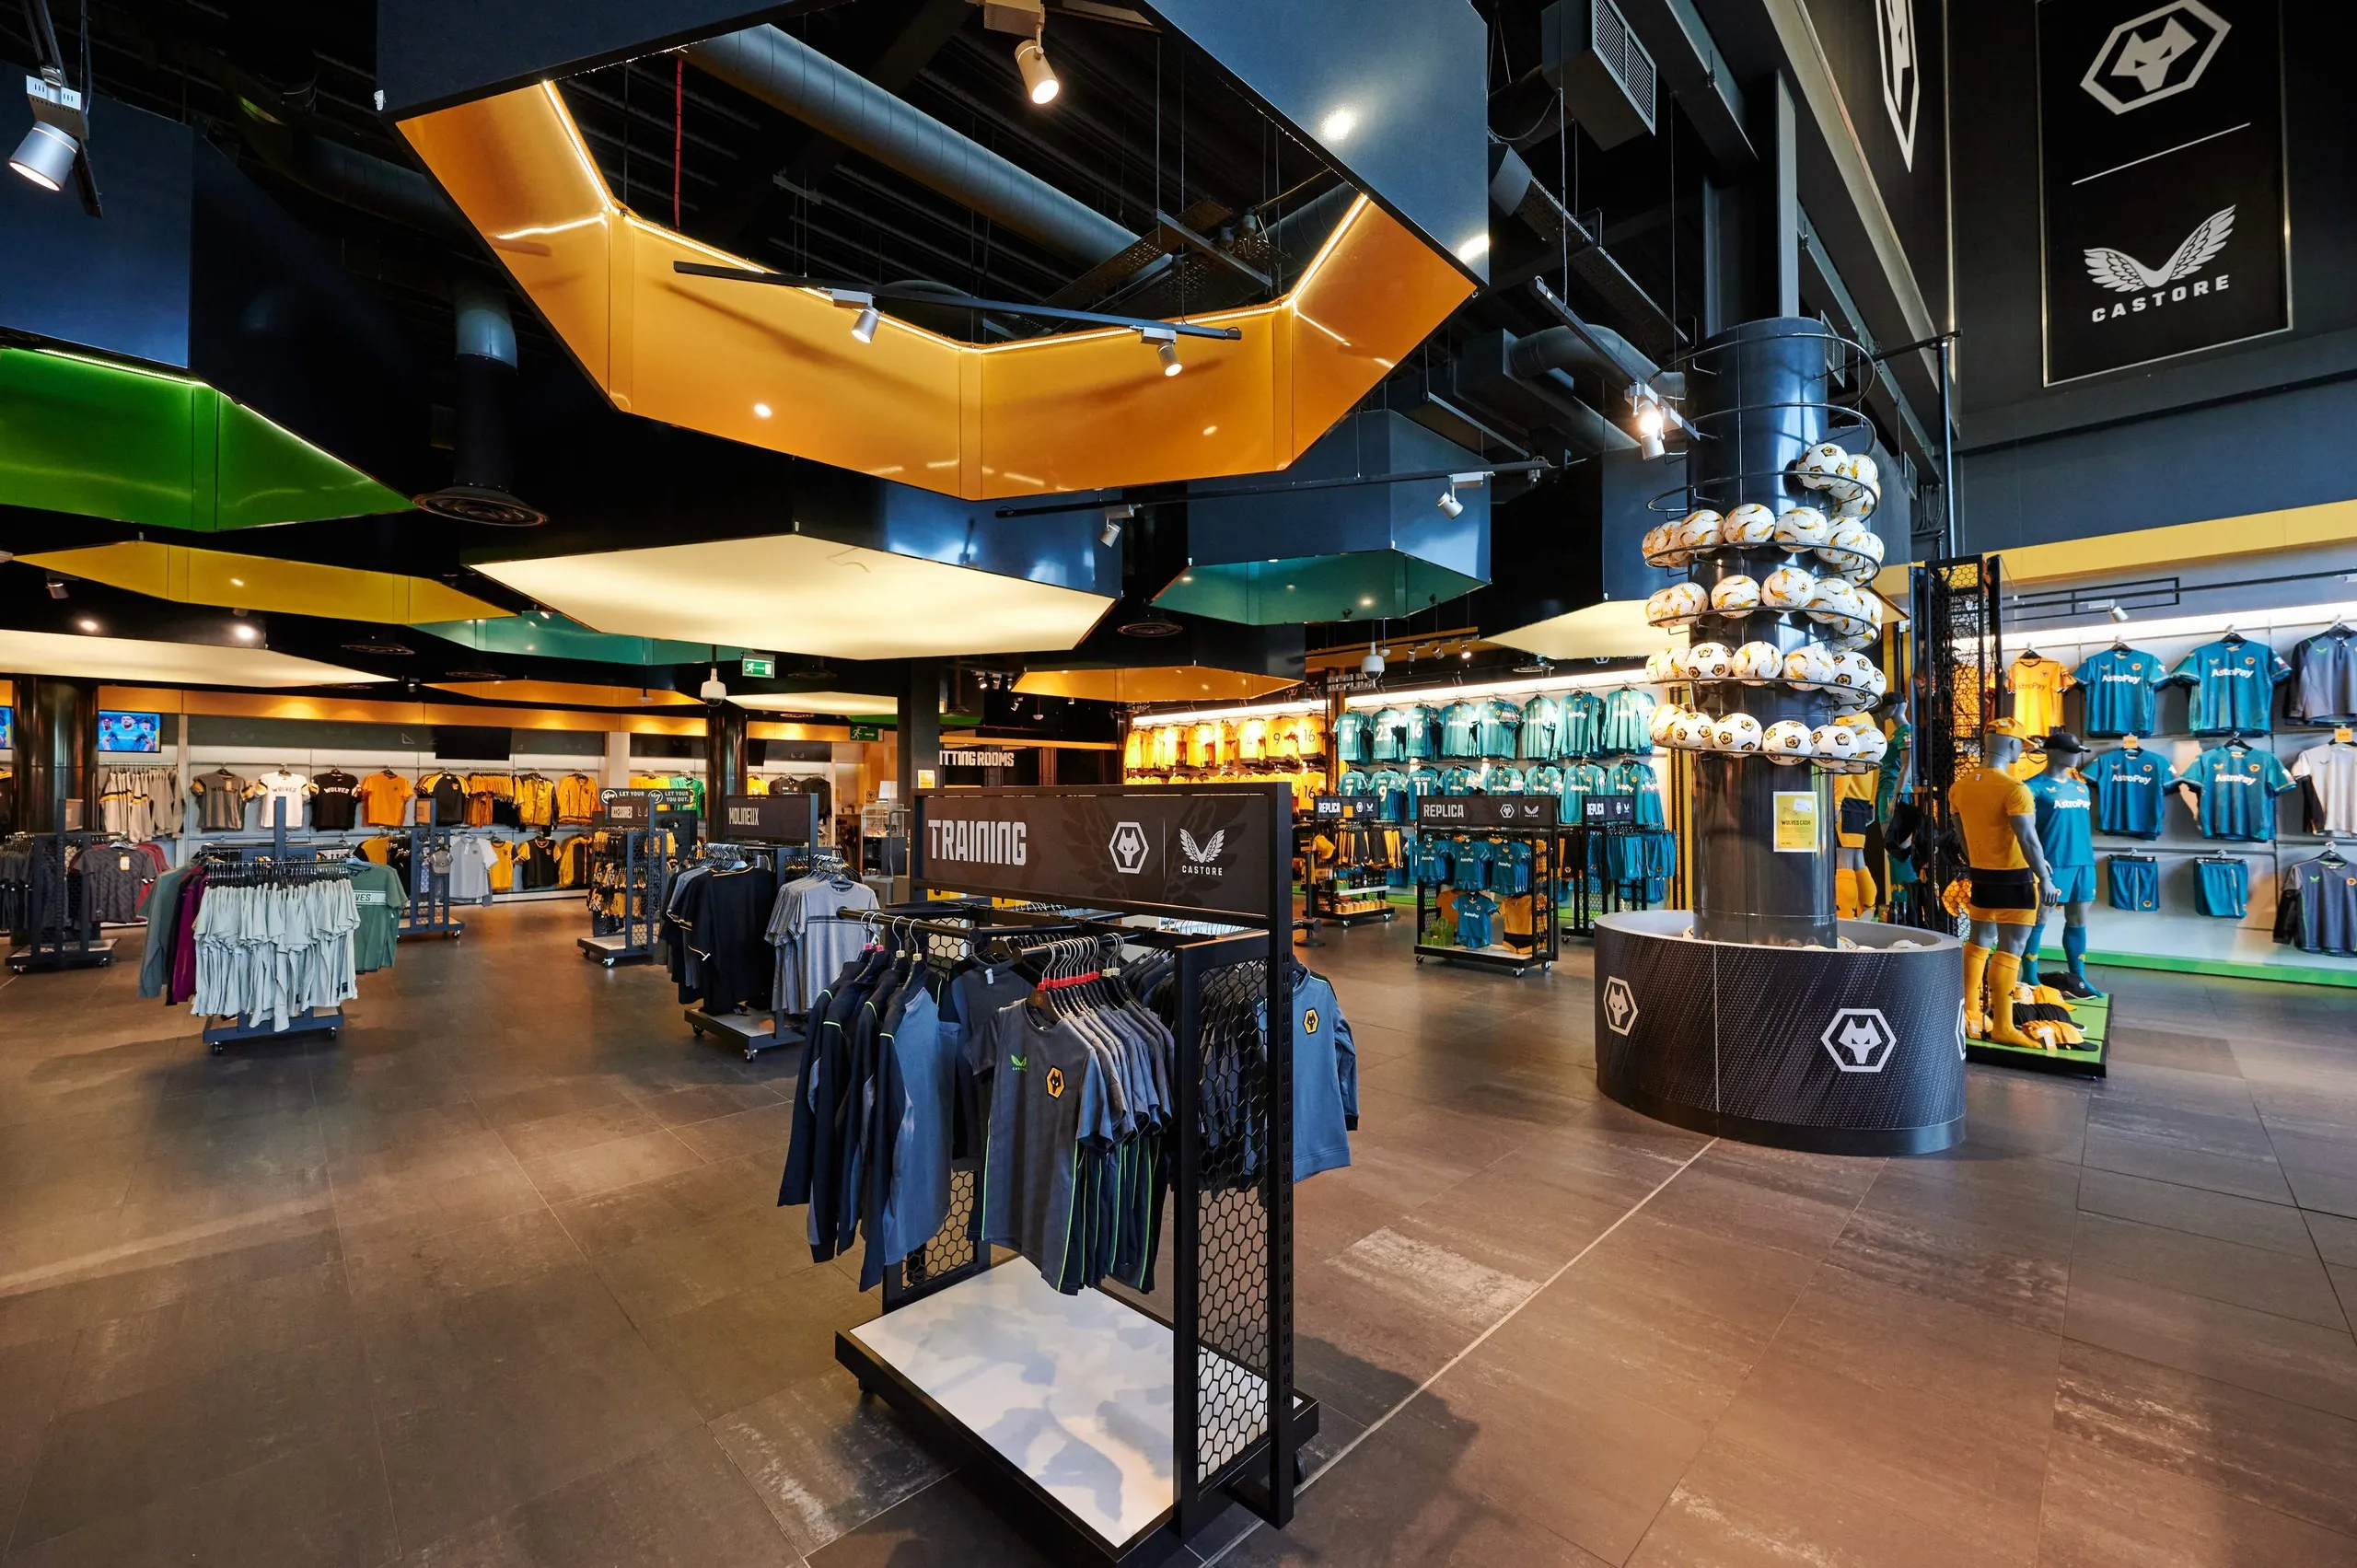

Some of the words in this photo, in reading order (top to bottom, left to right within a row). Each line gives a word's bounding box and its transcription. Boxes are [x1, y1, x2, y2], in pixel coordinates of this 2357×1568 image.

[2091, 274, 2230, 323] CASTORE
[2101, 674, 2142, 684] AstroPay
[2212, 668, 2254, 679] AstroPay
[1304, 728, 1316, 742] 16
[1411, 721, 1423, 738] 16
[1273, 732, 1281, 745] 9
[939, 750, 976, 766] ITTING
[977, 751, 1015, 767] ROOMS
[2111, 773, 2152, 784] AstroPay
[2215, 773, 2257, 785] AstroPay
[1304, 785, 1317, 799] 16
[1345, 785, 1353, 796] 7
[1378, 785, 1387, 802] 9
[1318, 802, 1341, 814] REPLICA
[1422, 804, 1464, 819] REPLICA
[1586, 803, 1605, 816] REPLICA
[728, 807, 760, 826] MOLINEUX
[927, 819, 1027, 866] TRAINING
[1181, 865, 1223, 877] CASTORE
[354, 893, 371, 901] VES
